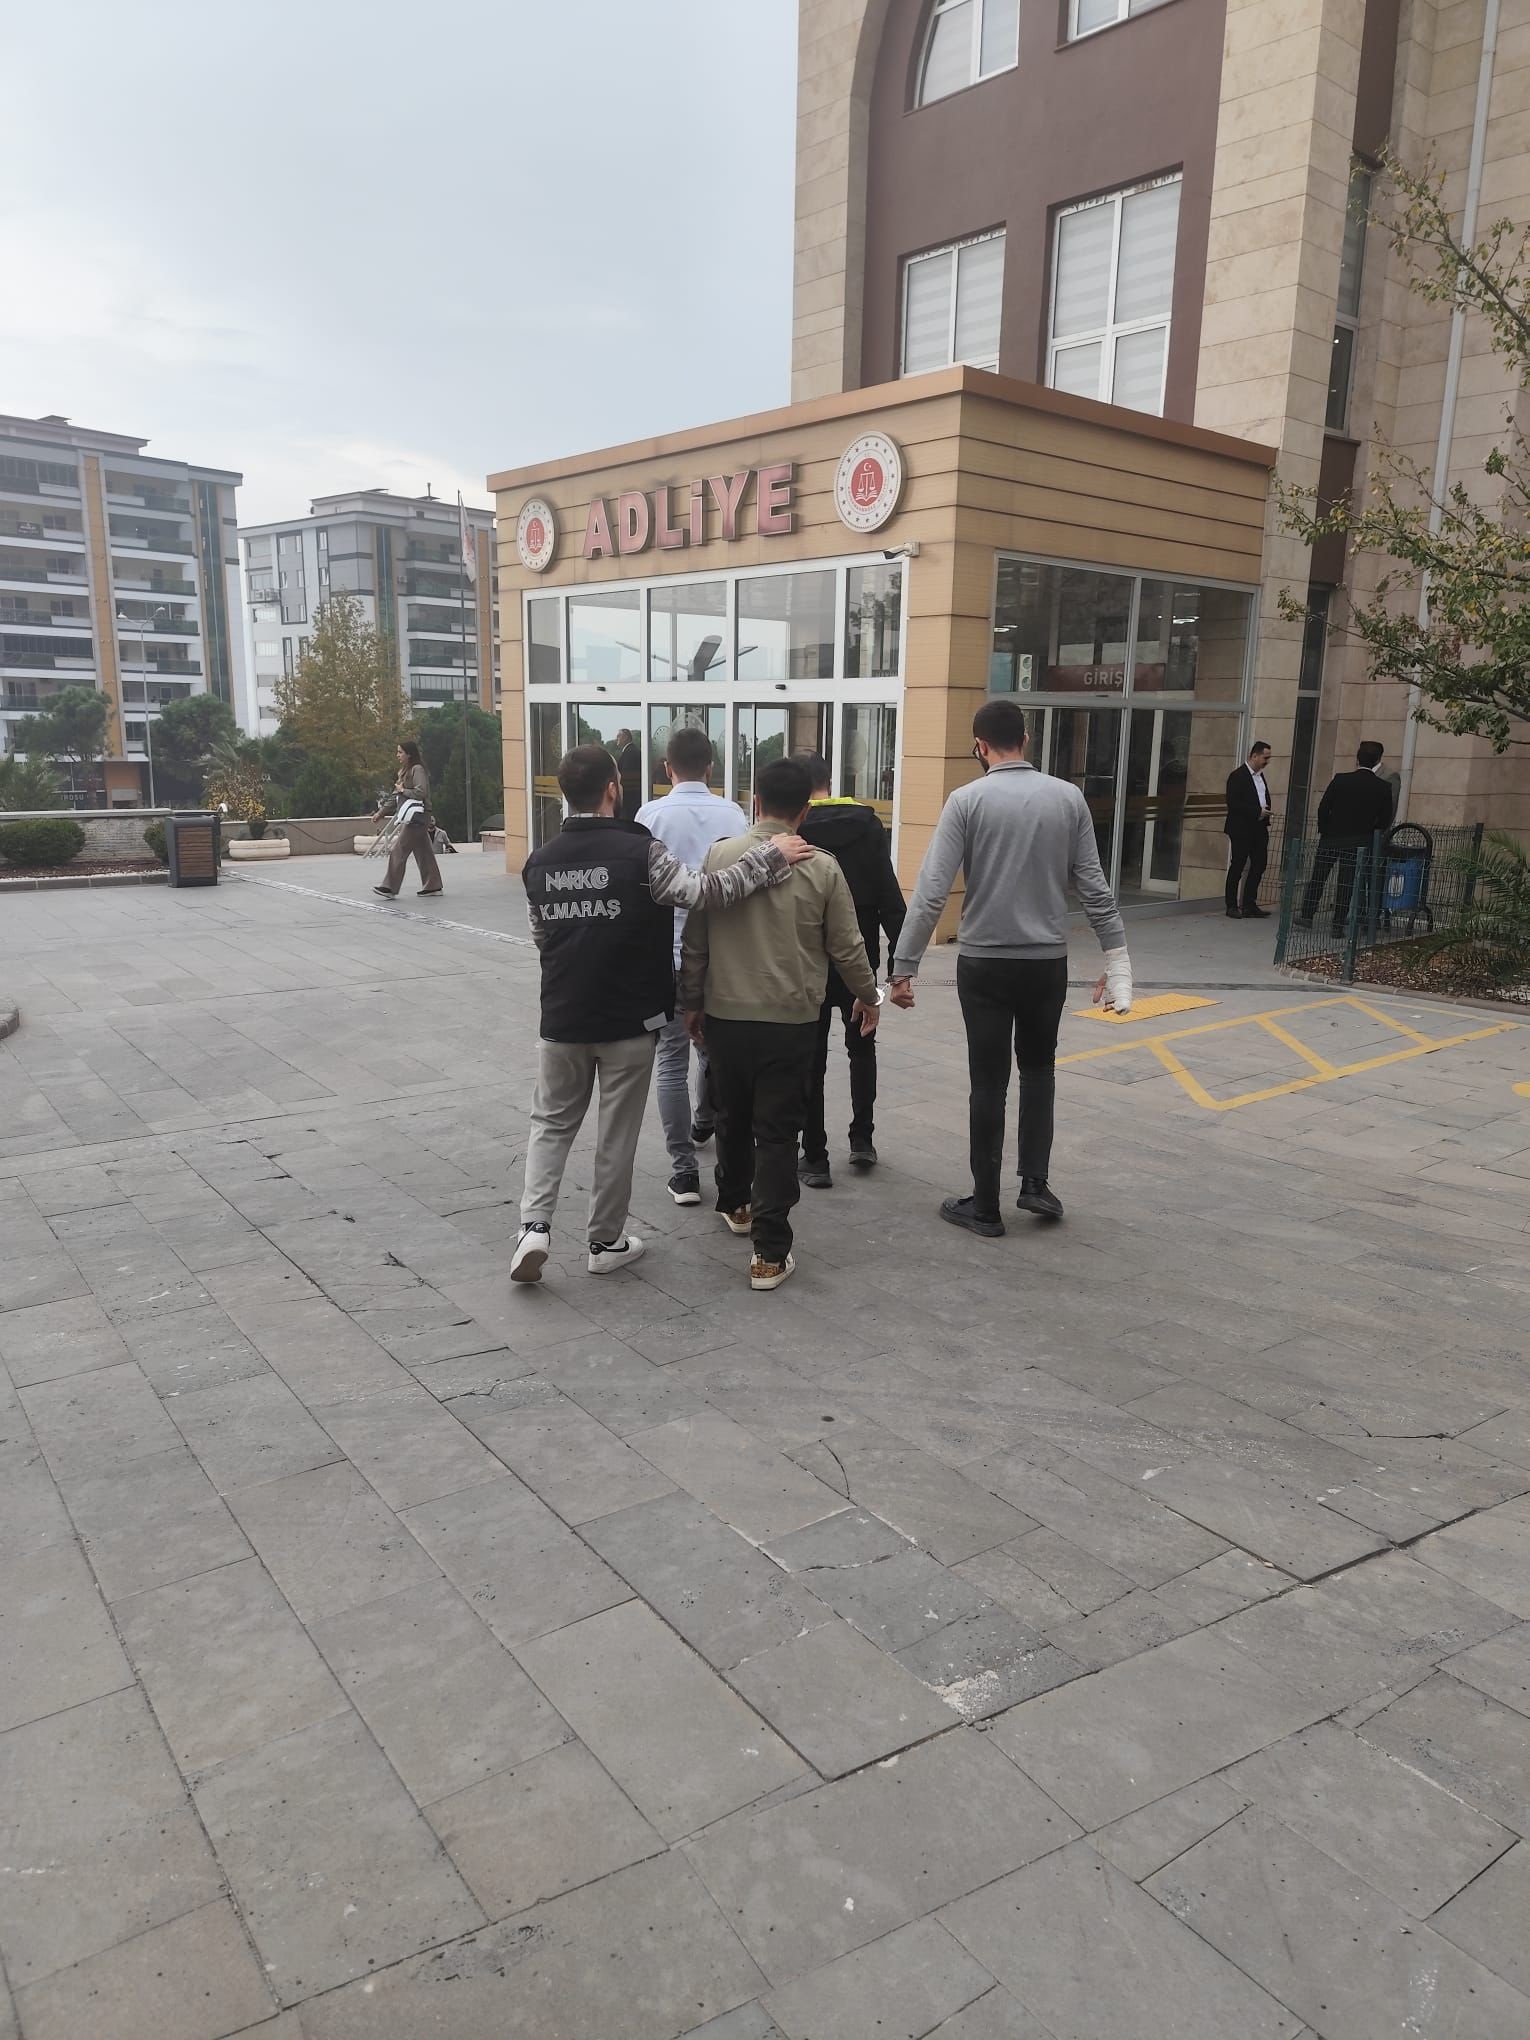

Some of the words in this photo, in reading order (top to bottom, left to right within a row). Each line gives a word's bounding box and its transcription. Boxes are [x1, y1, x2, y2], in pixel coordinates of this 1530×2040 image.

[583, 463, 796, 559] ADLİYE
[1083, 668, 1123, 687] GİRİŞ
[539, 899, 622, 921] K.MARAŞ
